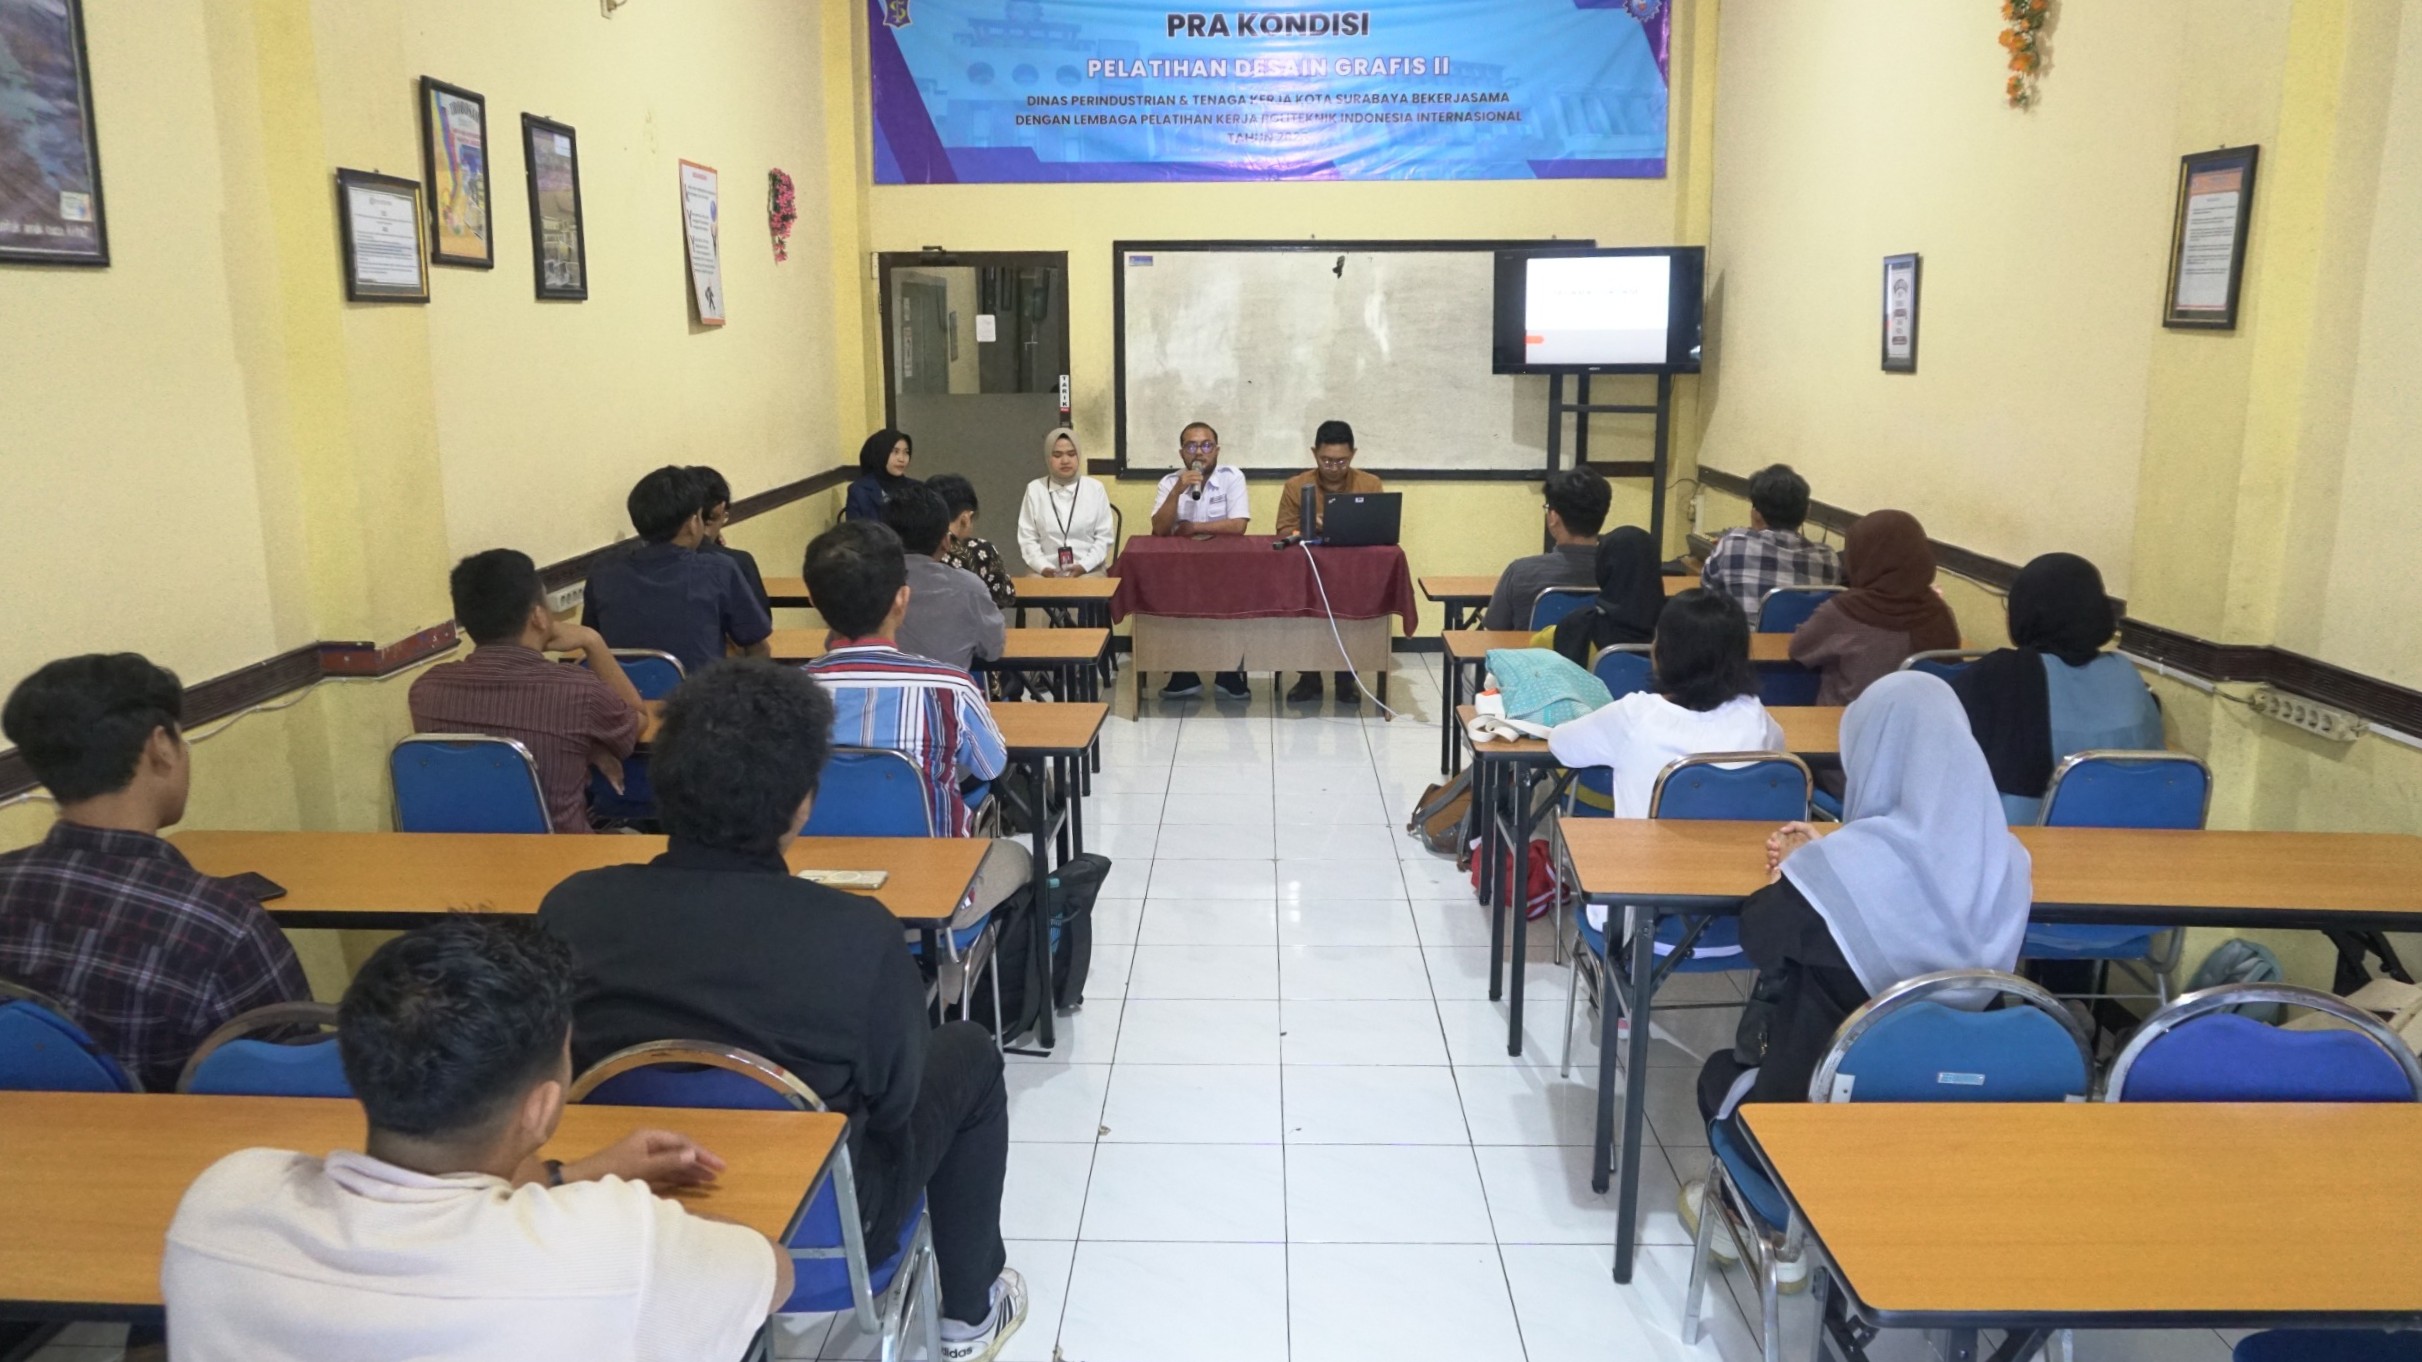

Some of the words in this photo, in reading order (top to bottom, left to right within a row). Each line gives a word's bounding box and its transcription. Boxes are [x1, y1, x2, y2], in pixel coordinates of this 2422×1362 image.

[1167, 13, 1231, 37] PRA
[1237, 12, 1369, 37] KONDISI
[1088, 58, 1227, 78] PELATIHAN
[1234, 58, 1328, 78] DESAIN
[1335, 56, 1426, 77] GRAFIS
[1434, 56, 1449, 76] II
[1027, 95, 1068, 106] DINAS
[1071, 95, 1175, 106] PERINDUSTRIAN
[1180, 95, 1188, 105] &
[1192, 94, 1246, 106] TENAGA
[1250, 94, 1291, 105] KERJA
[1296, 94, 1331, 104] KOTA
[1336, 93, 1409, 105] SURABAYA
[1412, 92, 1510, 104] BEKERJASAMA
[1016, 114, 1071, 126] DENGAN
[1074, 114, 1137, 125] LEMBAGA
[1141, 113, 1213, 125] PELATIHAN
[1216, 113, 1258, 124] KERJA
[1341, 112, 1413, 123] INDONESIA
[1417, 111, 1522, 122] INTERNASIONAL
[1227, 132, 1274, 143] TAHUN
[941, 1346, 973, 1359] didas
